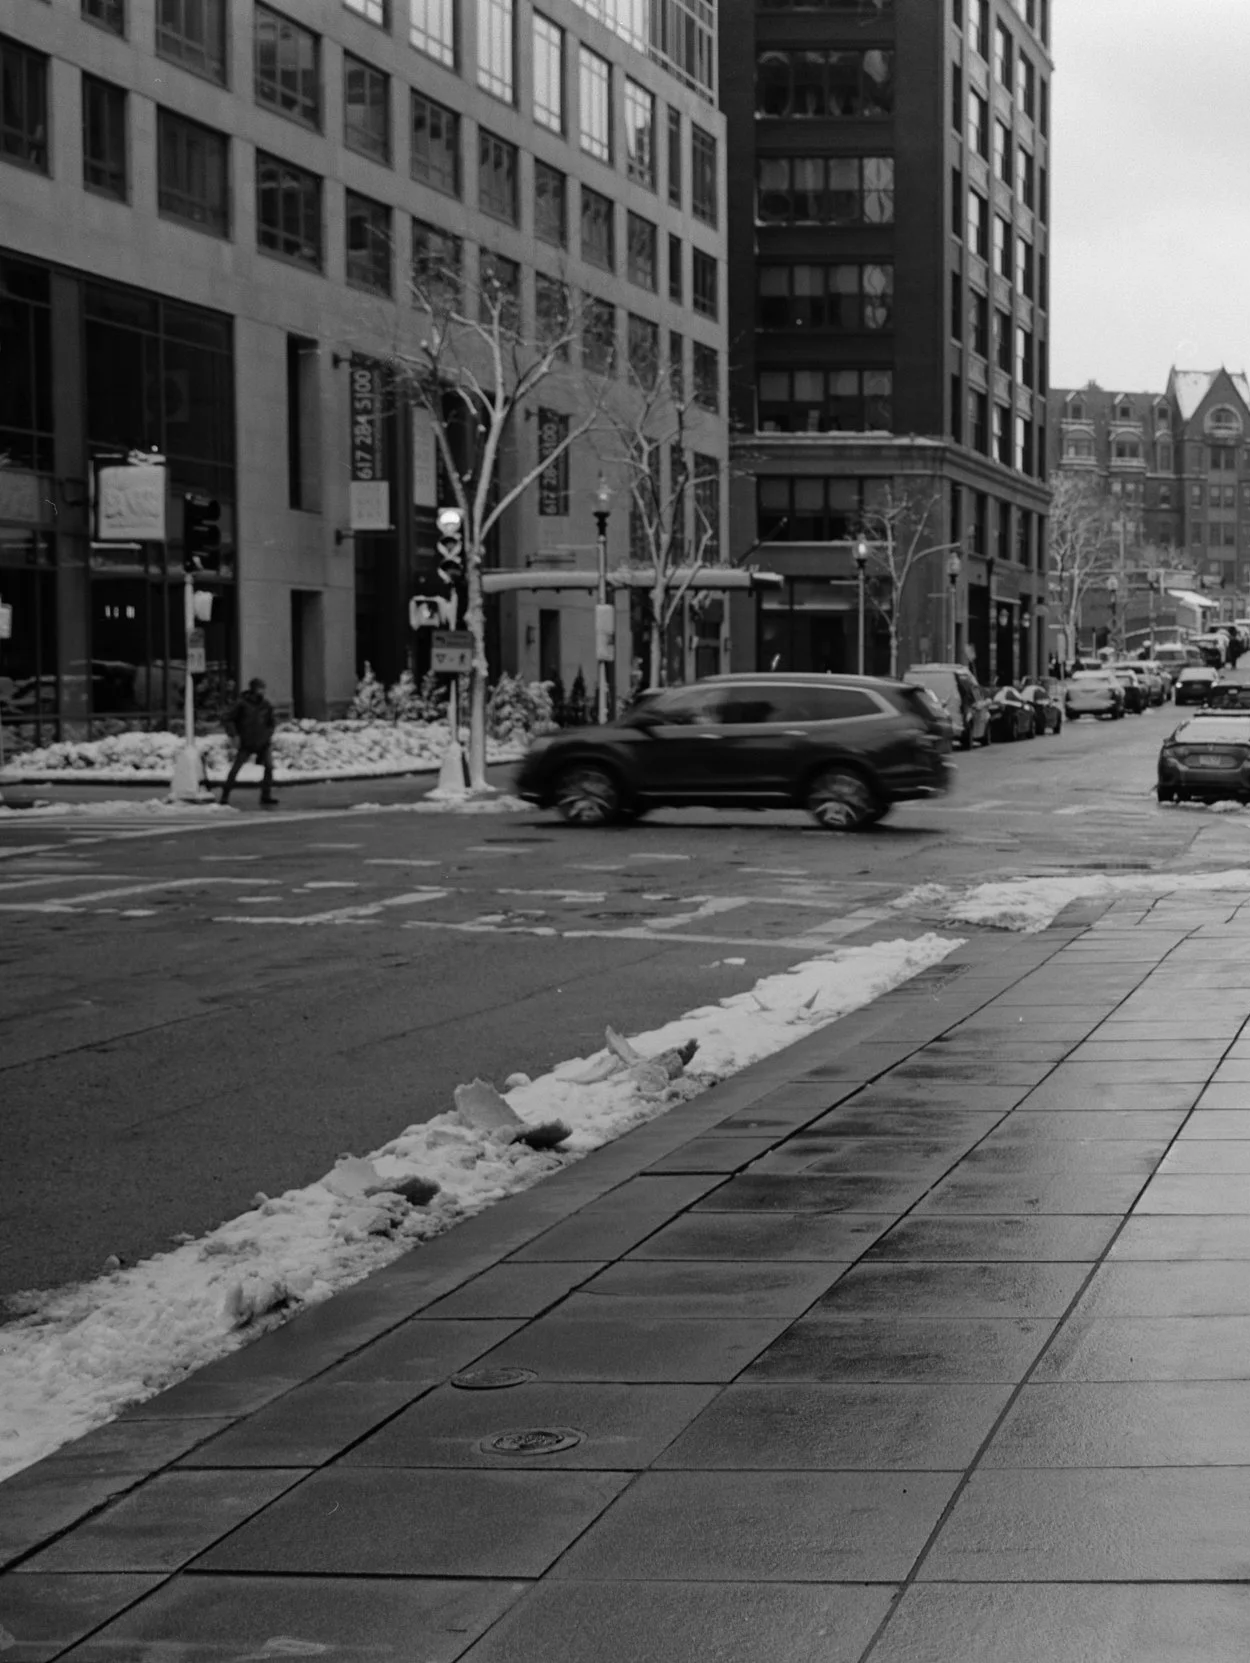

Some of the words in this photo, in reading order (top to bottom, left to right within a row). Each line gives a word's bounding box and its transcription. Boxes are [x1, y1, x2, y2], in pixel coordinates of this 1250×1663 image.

[354, 369, 373, 411] 5100
[354, 451, 373, 480] 617
[542, 490, 557, 514] 617
